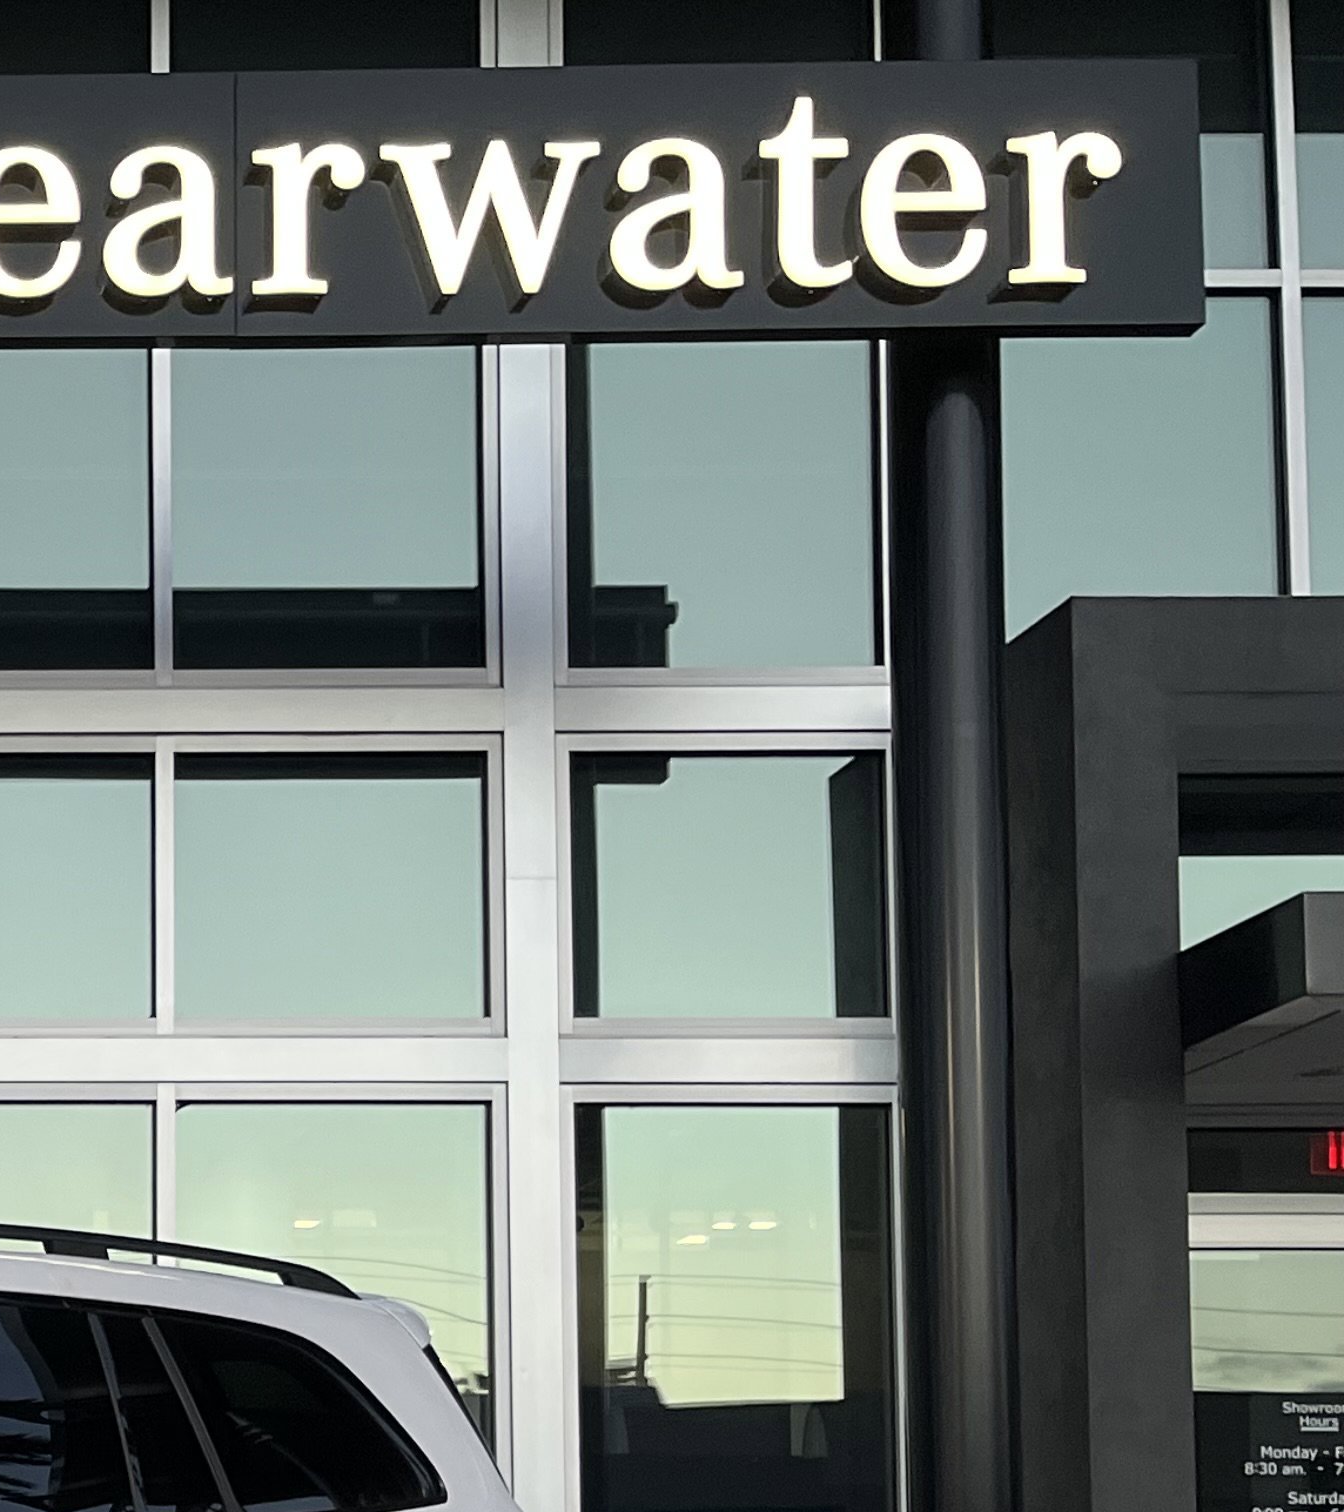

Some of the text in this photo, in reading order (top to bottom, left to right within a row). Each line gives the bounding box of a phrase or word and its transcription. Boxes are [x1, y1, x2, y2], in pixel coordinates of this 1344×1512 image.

[1282, 1401, 1344, 1414] Showroo
[1299, 1415, 1339, 1429] Hours
[1260, 1445, 1319, 1462] Monday
[1244, 1461, 1278, 1476] 8:30
[1282, 1465, 1307, 1476] am.
[1287, 1490, 1344, 1505] Saturda
